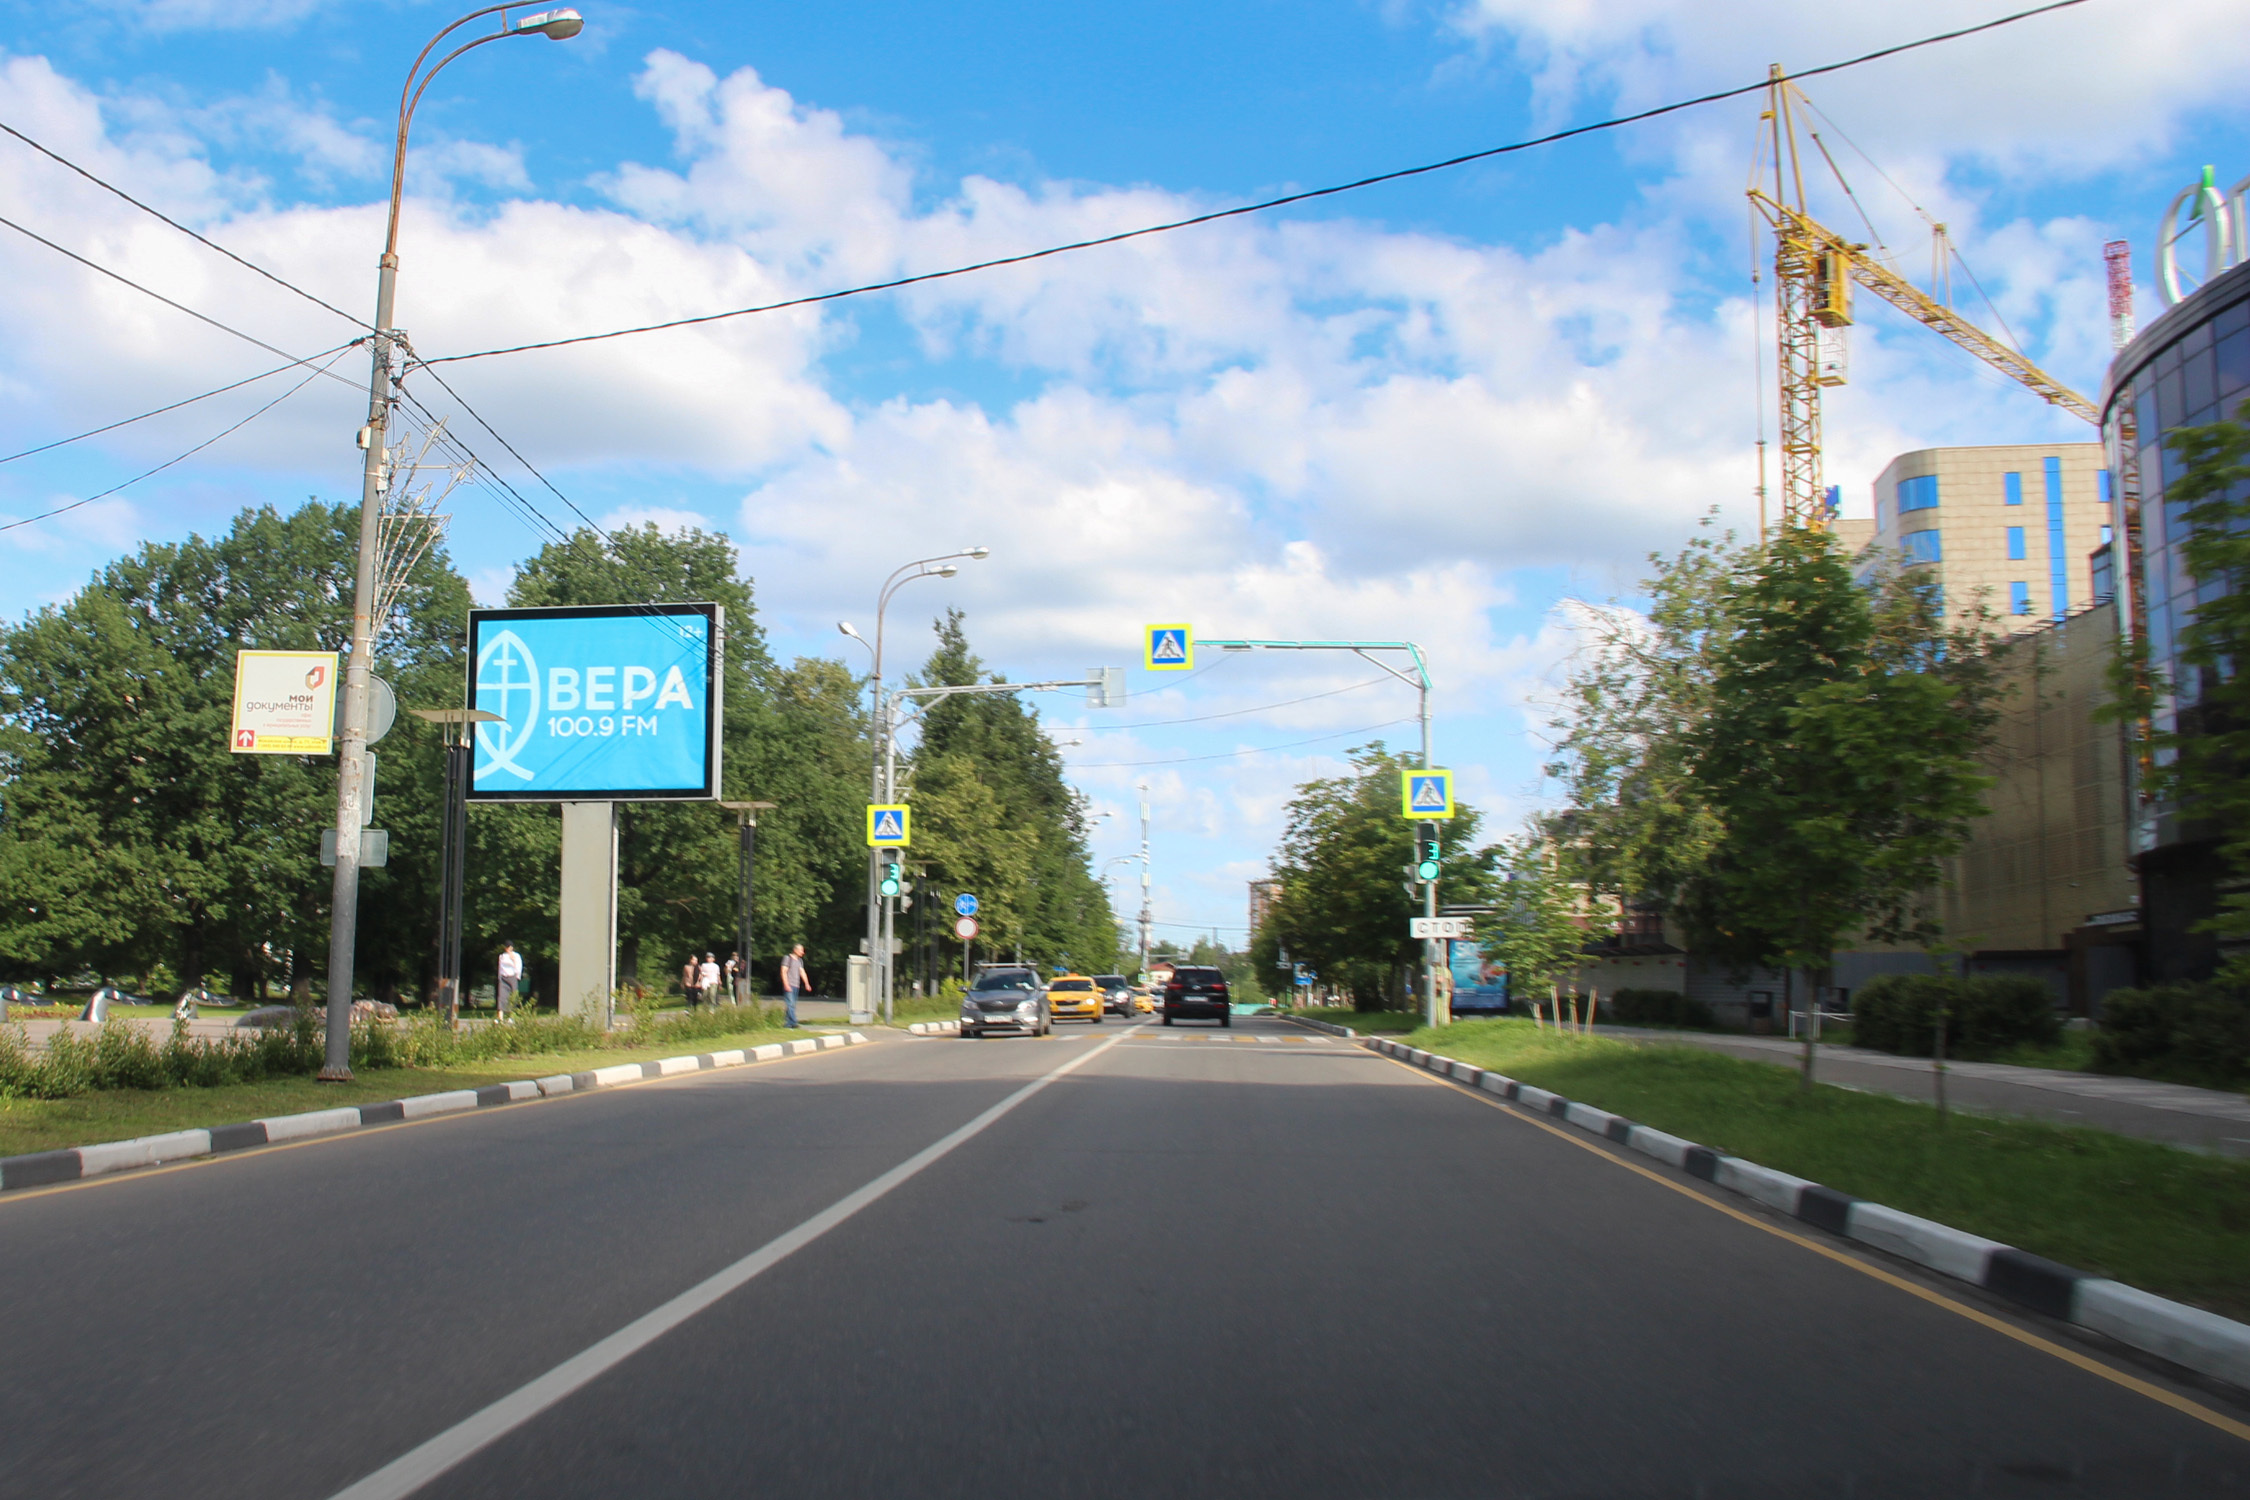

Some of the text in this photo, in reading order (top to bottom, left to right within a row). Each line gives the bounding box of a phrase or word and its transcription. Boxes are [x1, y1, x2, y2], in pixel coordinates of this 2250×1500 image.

[680, 625, 703, 638] 12+
[548, 665, 694, 711] ВЕРА
[289, 694, 314, 703] мои
[246, 701, 313, 713] документы
[547, 715, 657, 737] 100.9 FM
